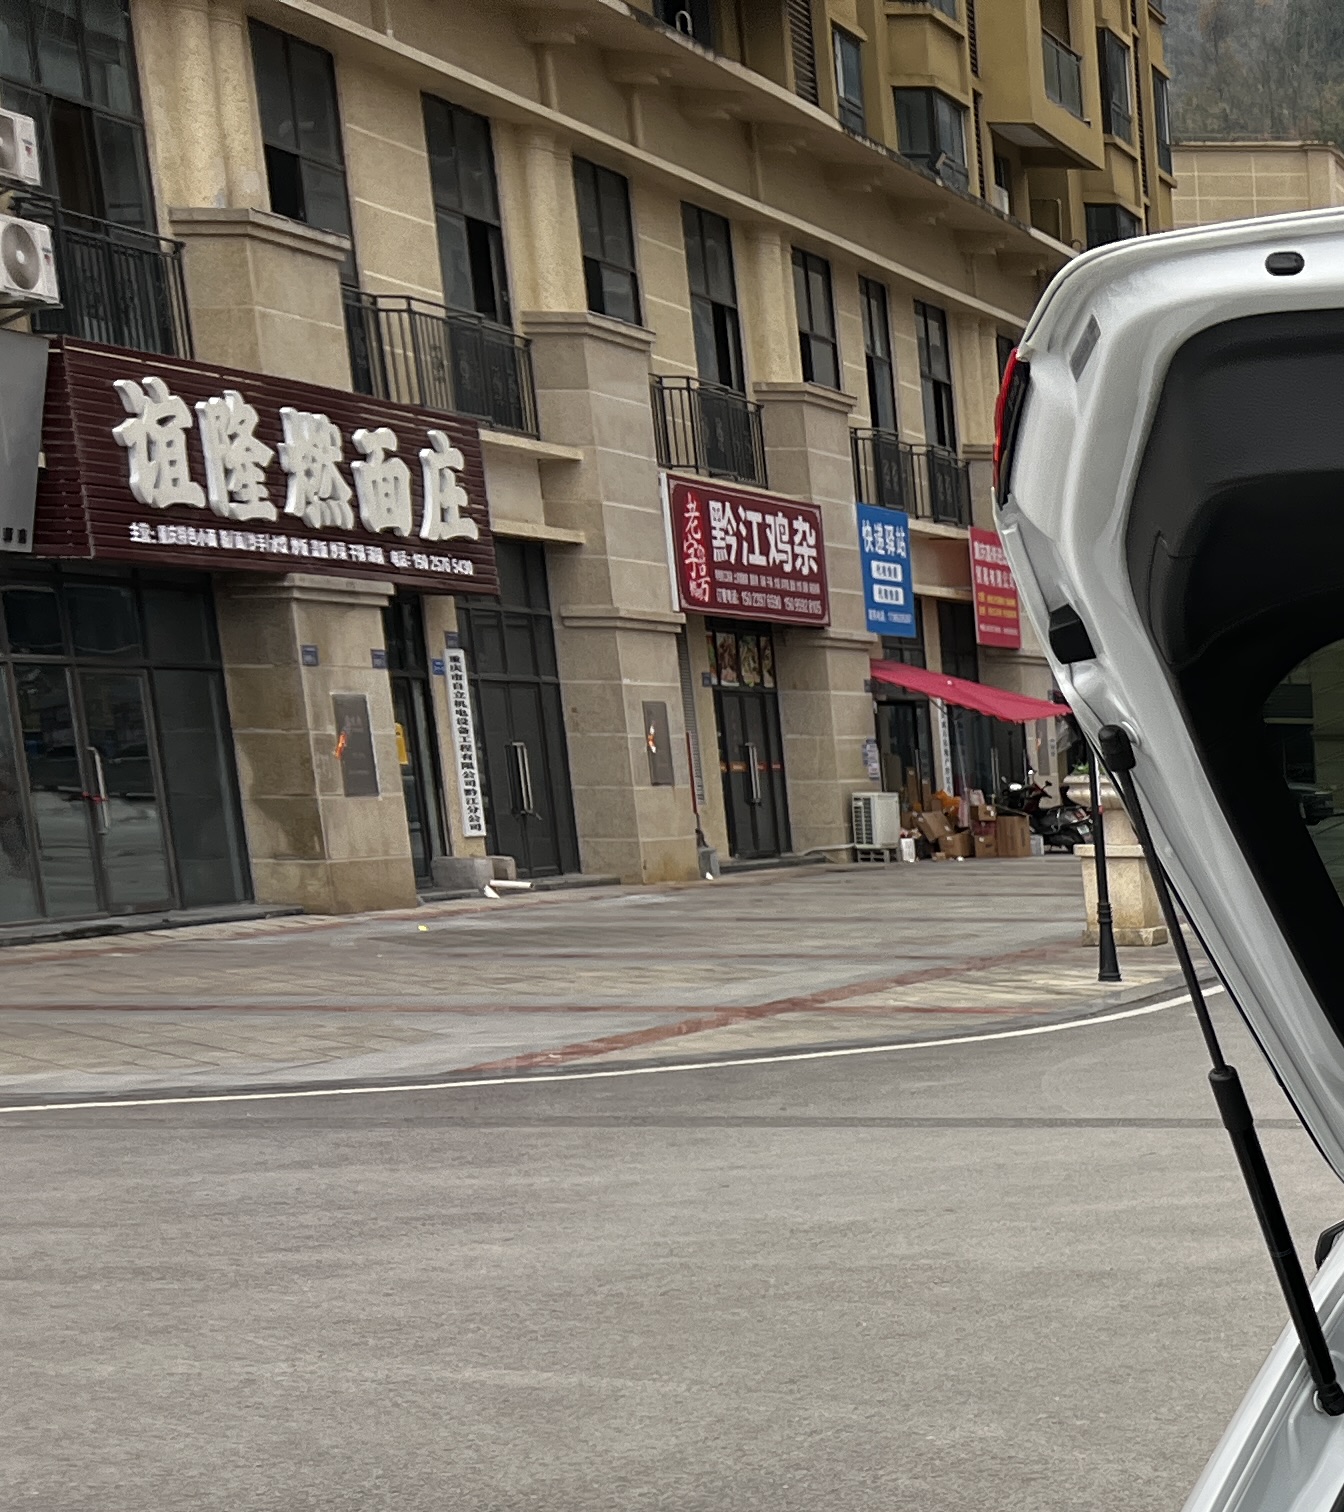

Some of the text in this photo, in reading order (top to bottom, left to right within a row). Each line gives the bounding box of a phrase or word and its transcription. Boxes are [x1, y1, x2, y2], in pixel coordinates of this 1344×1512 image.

[112, 376, 479, 542] 谊隆燃面庄
[708, 500, 818, 576] 黔江鸡杂
[862, 519, 907, 558] 快递驿站
